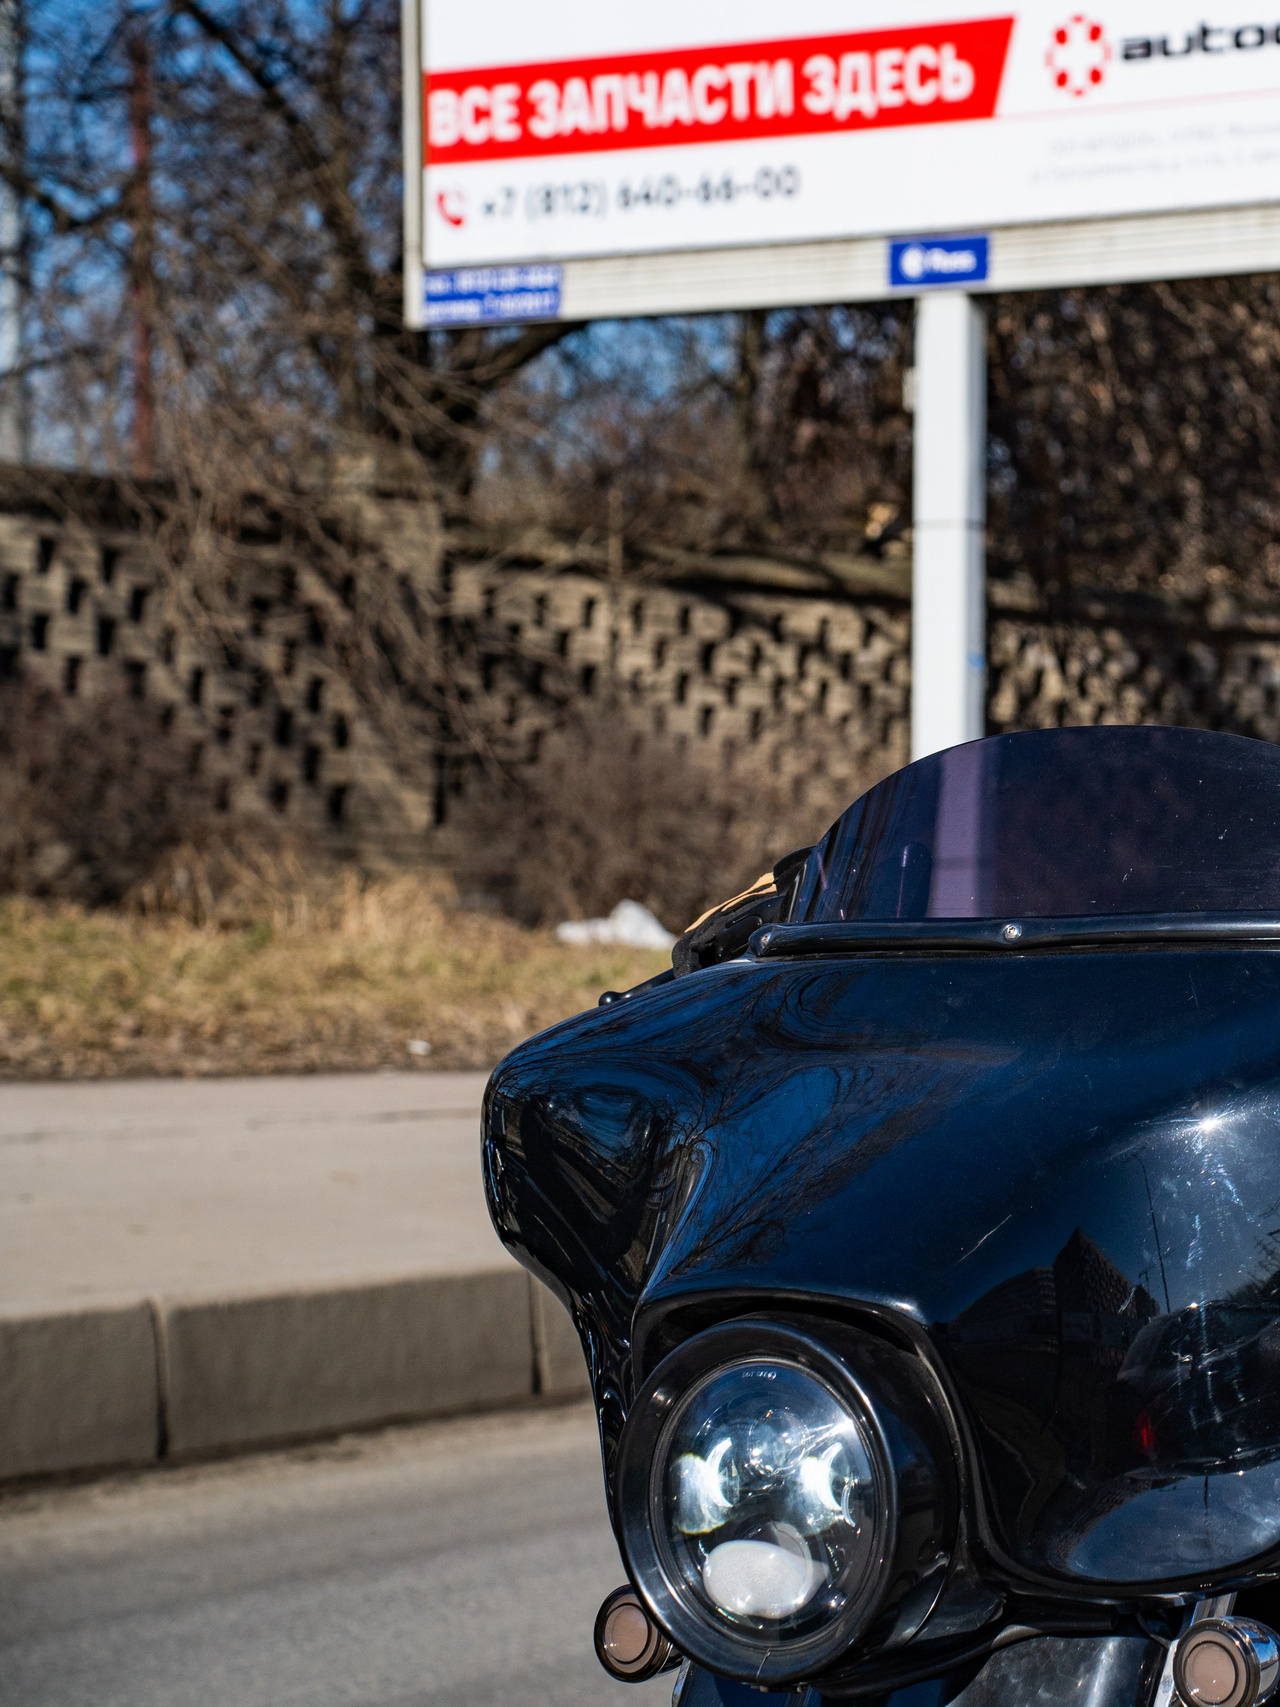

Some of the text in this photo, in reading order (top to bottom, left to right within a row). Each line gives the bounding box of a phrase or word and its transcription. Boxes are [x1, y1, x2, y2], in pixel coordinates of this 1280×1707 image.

[427, 42, 976, 148] ВСЕ ЗАПЧАСТИ ЗДЕСЬ
[482, 164, 802, 223] +7 (812) 640-66-00
